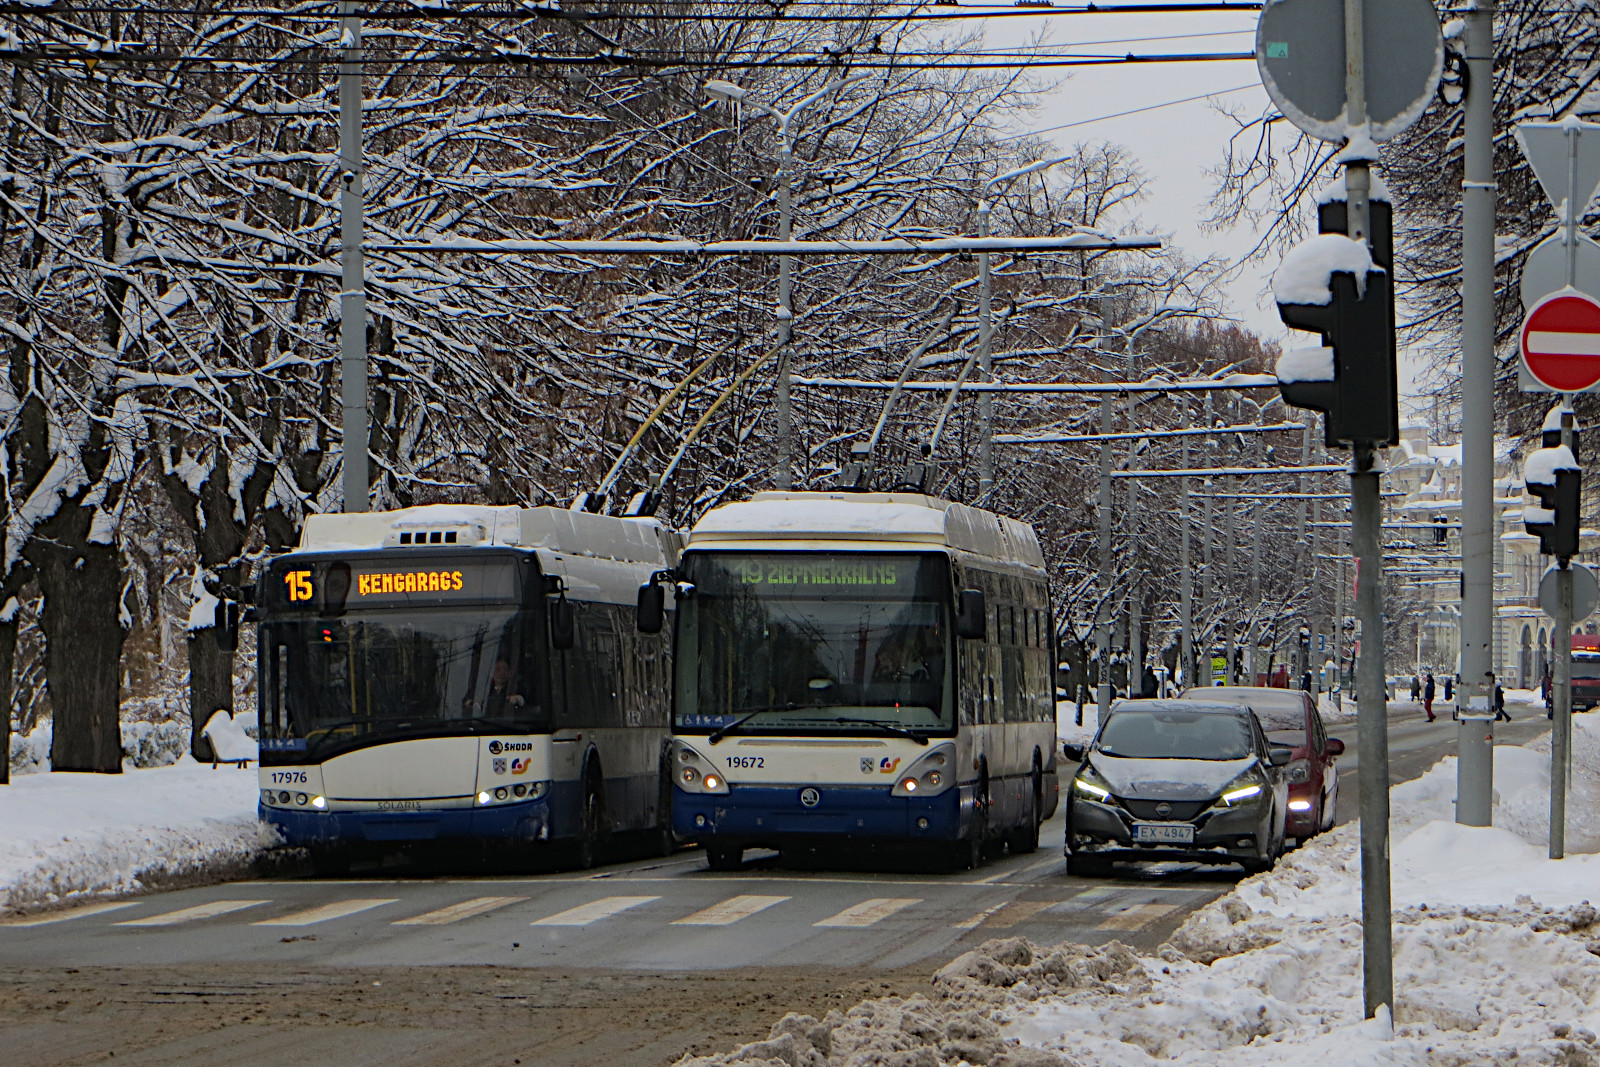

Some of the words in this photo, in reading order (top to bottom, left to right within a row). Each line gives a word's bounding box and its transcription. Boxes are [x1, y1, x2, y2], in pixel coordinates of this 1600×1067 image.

[735, 560, 763, 584] 19
[767, 563, 897, 585] ZIEPNIEKKALNS
[284, 570, 313, 601] 15
[358, 571, 463, 595] ĶENGARAGS
[504, 741, 533, 752] ŠKODA
[725, 756, 765, 769] 19672
[271, 771, 308, 784] 17976
[377, 801, 421, 810] SOLARIS
[1140, 827, 1192, 838] EX-4947
